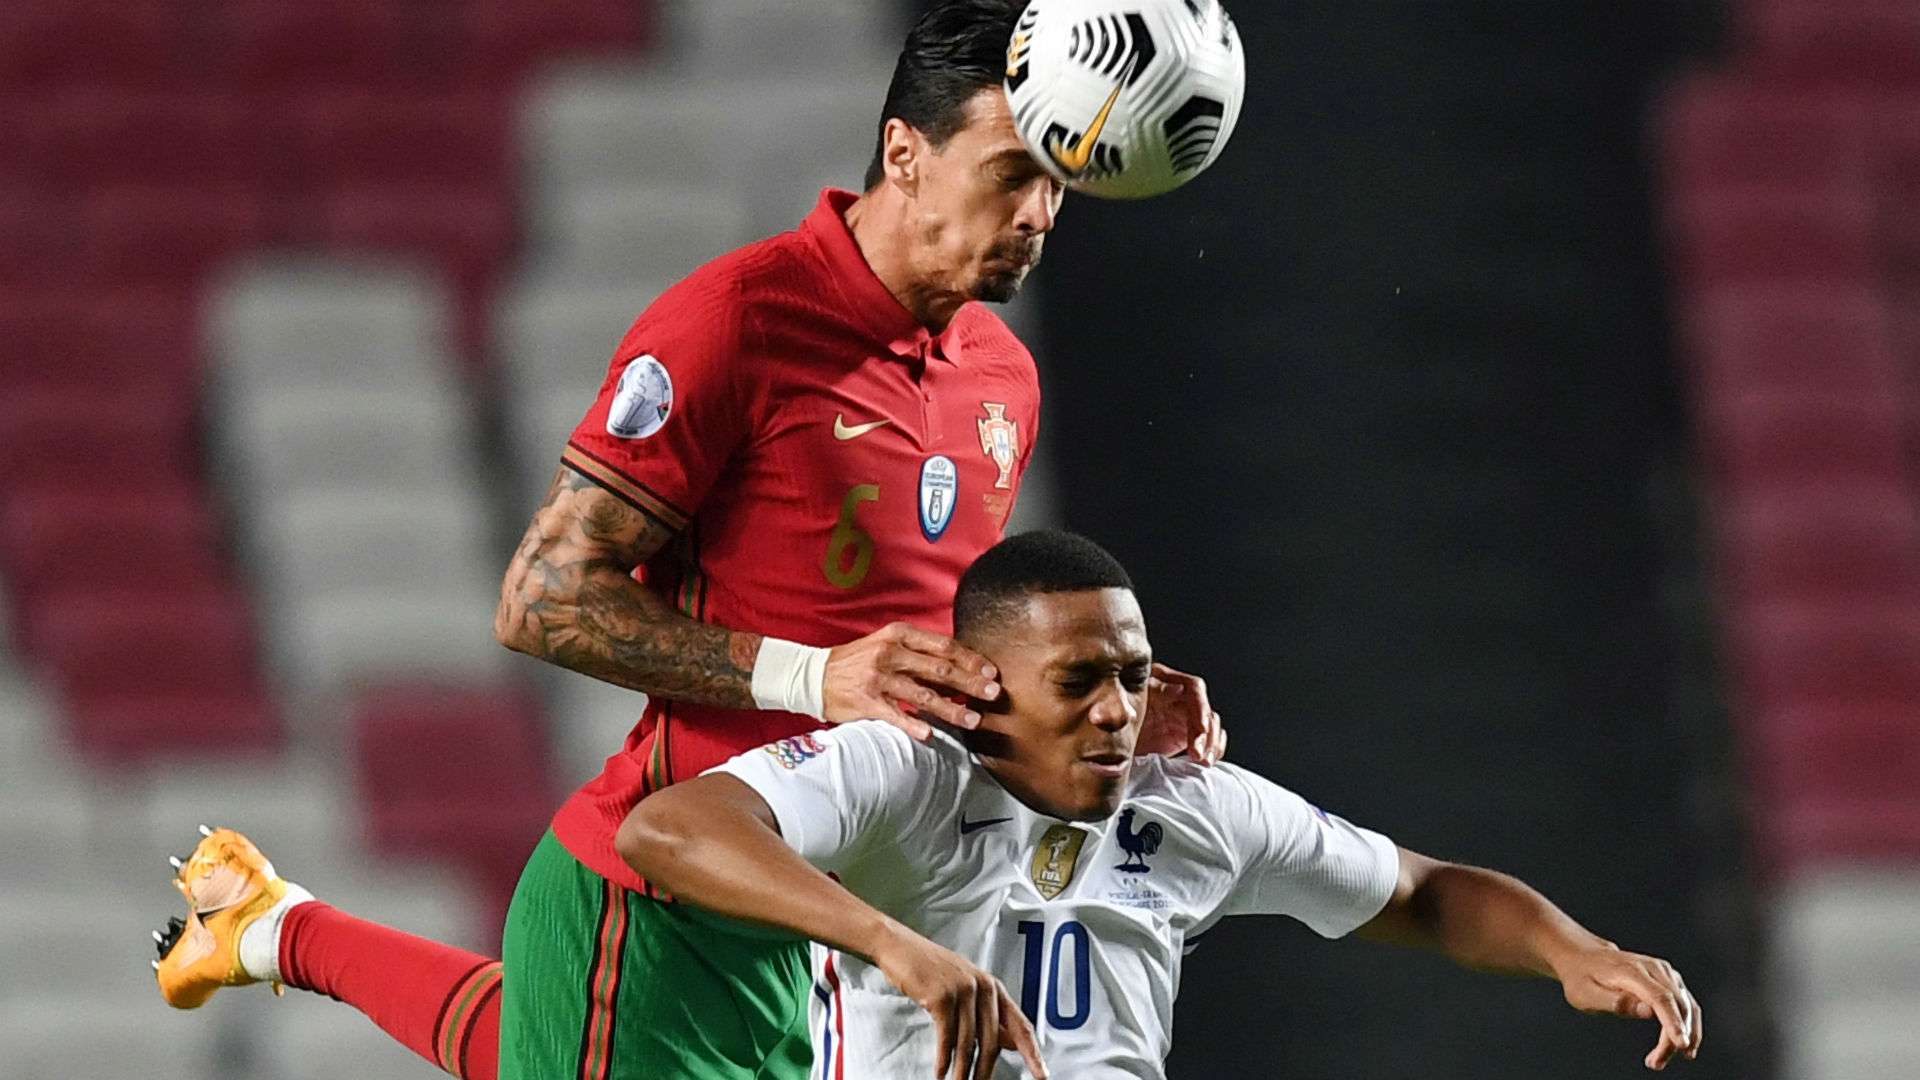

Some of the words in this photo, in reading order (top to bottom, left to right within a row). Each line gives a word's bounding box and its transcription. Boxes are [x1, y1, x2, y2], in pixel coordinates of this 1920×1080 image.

[824, 483, 880, 588] 6
[1041, 869, 1061, 882] FIFA
[1017, 920, 1091, 1031] 10
